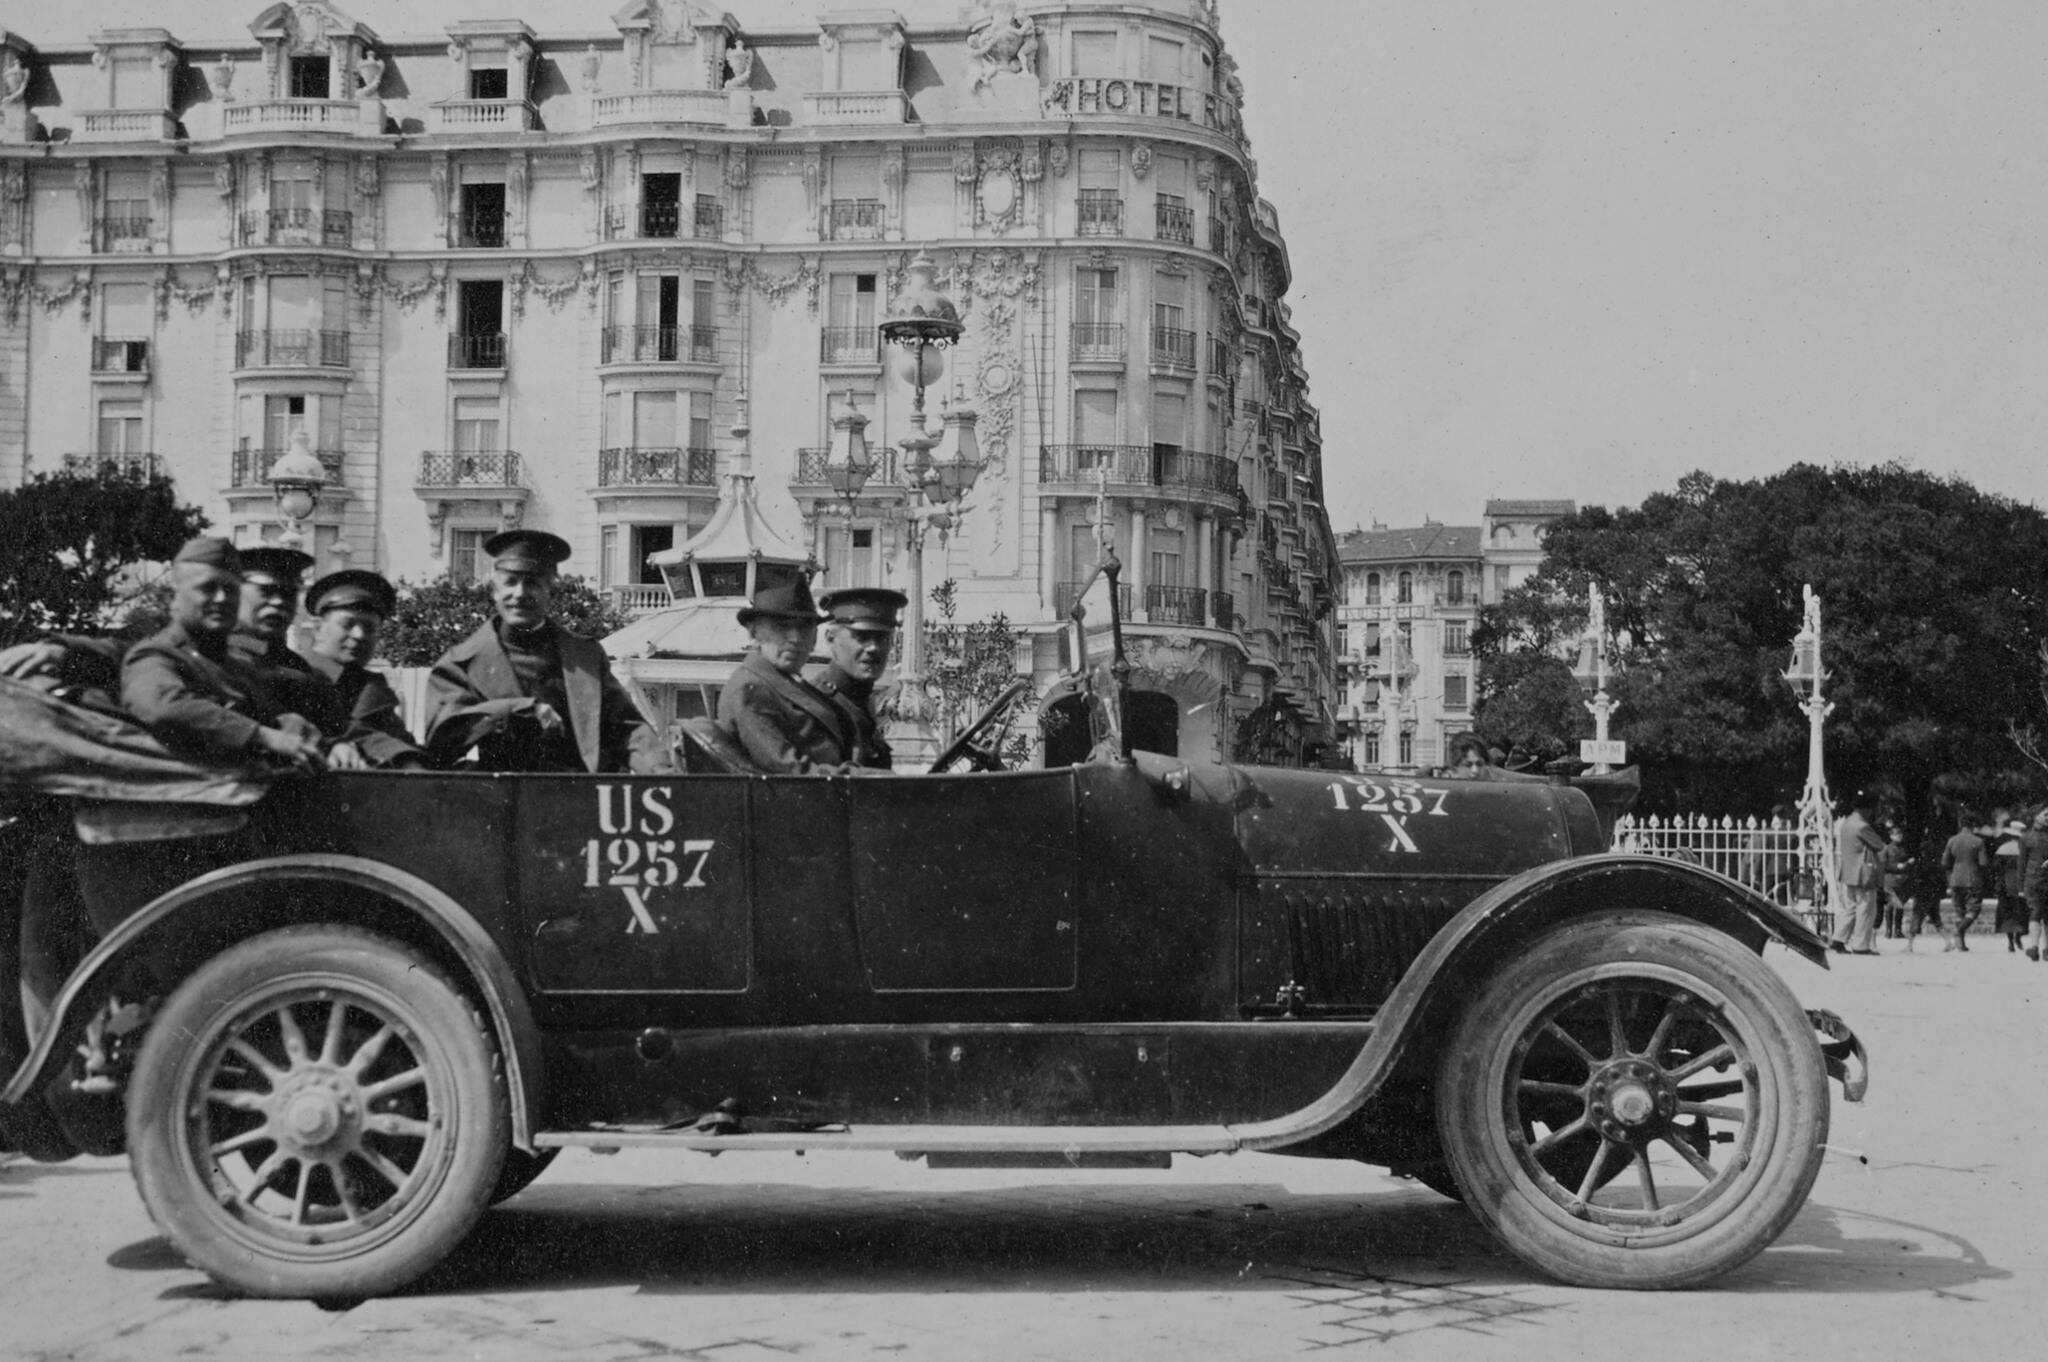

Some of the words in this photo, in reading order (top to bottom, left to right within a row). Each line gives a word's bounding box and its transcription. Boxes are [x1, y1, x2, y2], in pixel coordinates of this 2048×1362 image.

[1078, 79, 1192, 121] HOTEL
[596, 784, 674, 836] US
[1325, 782, 1449, 815] 1257
[1380, 813, 1421, 853] X
[579, 838, 716, 887] 1257
[620, 886, 660, 933] X
